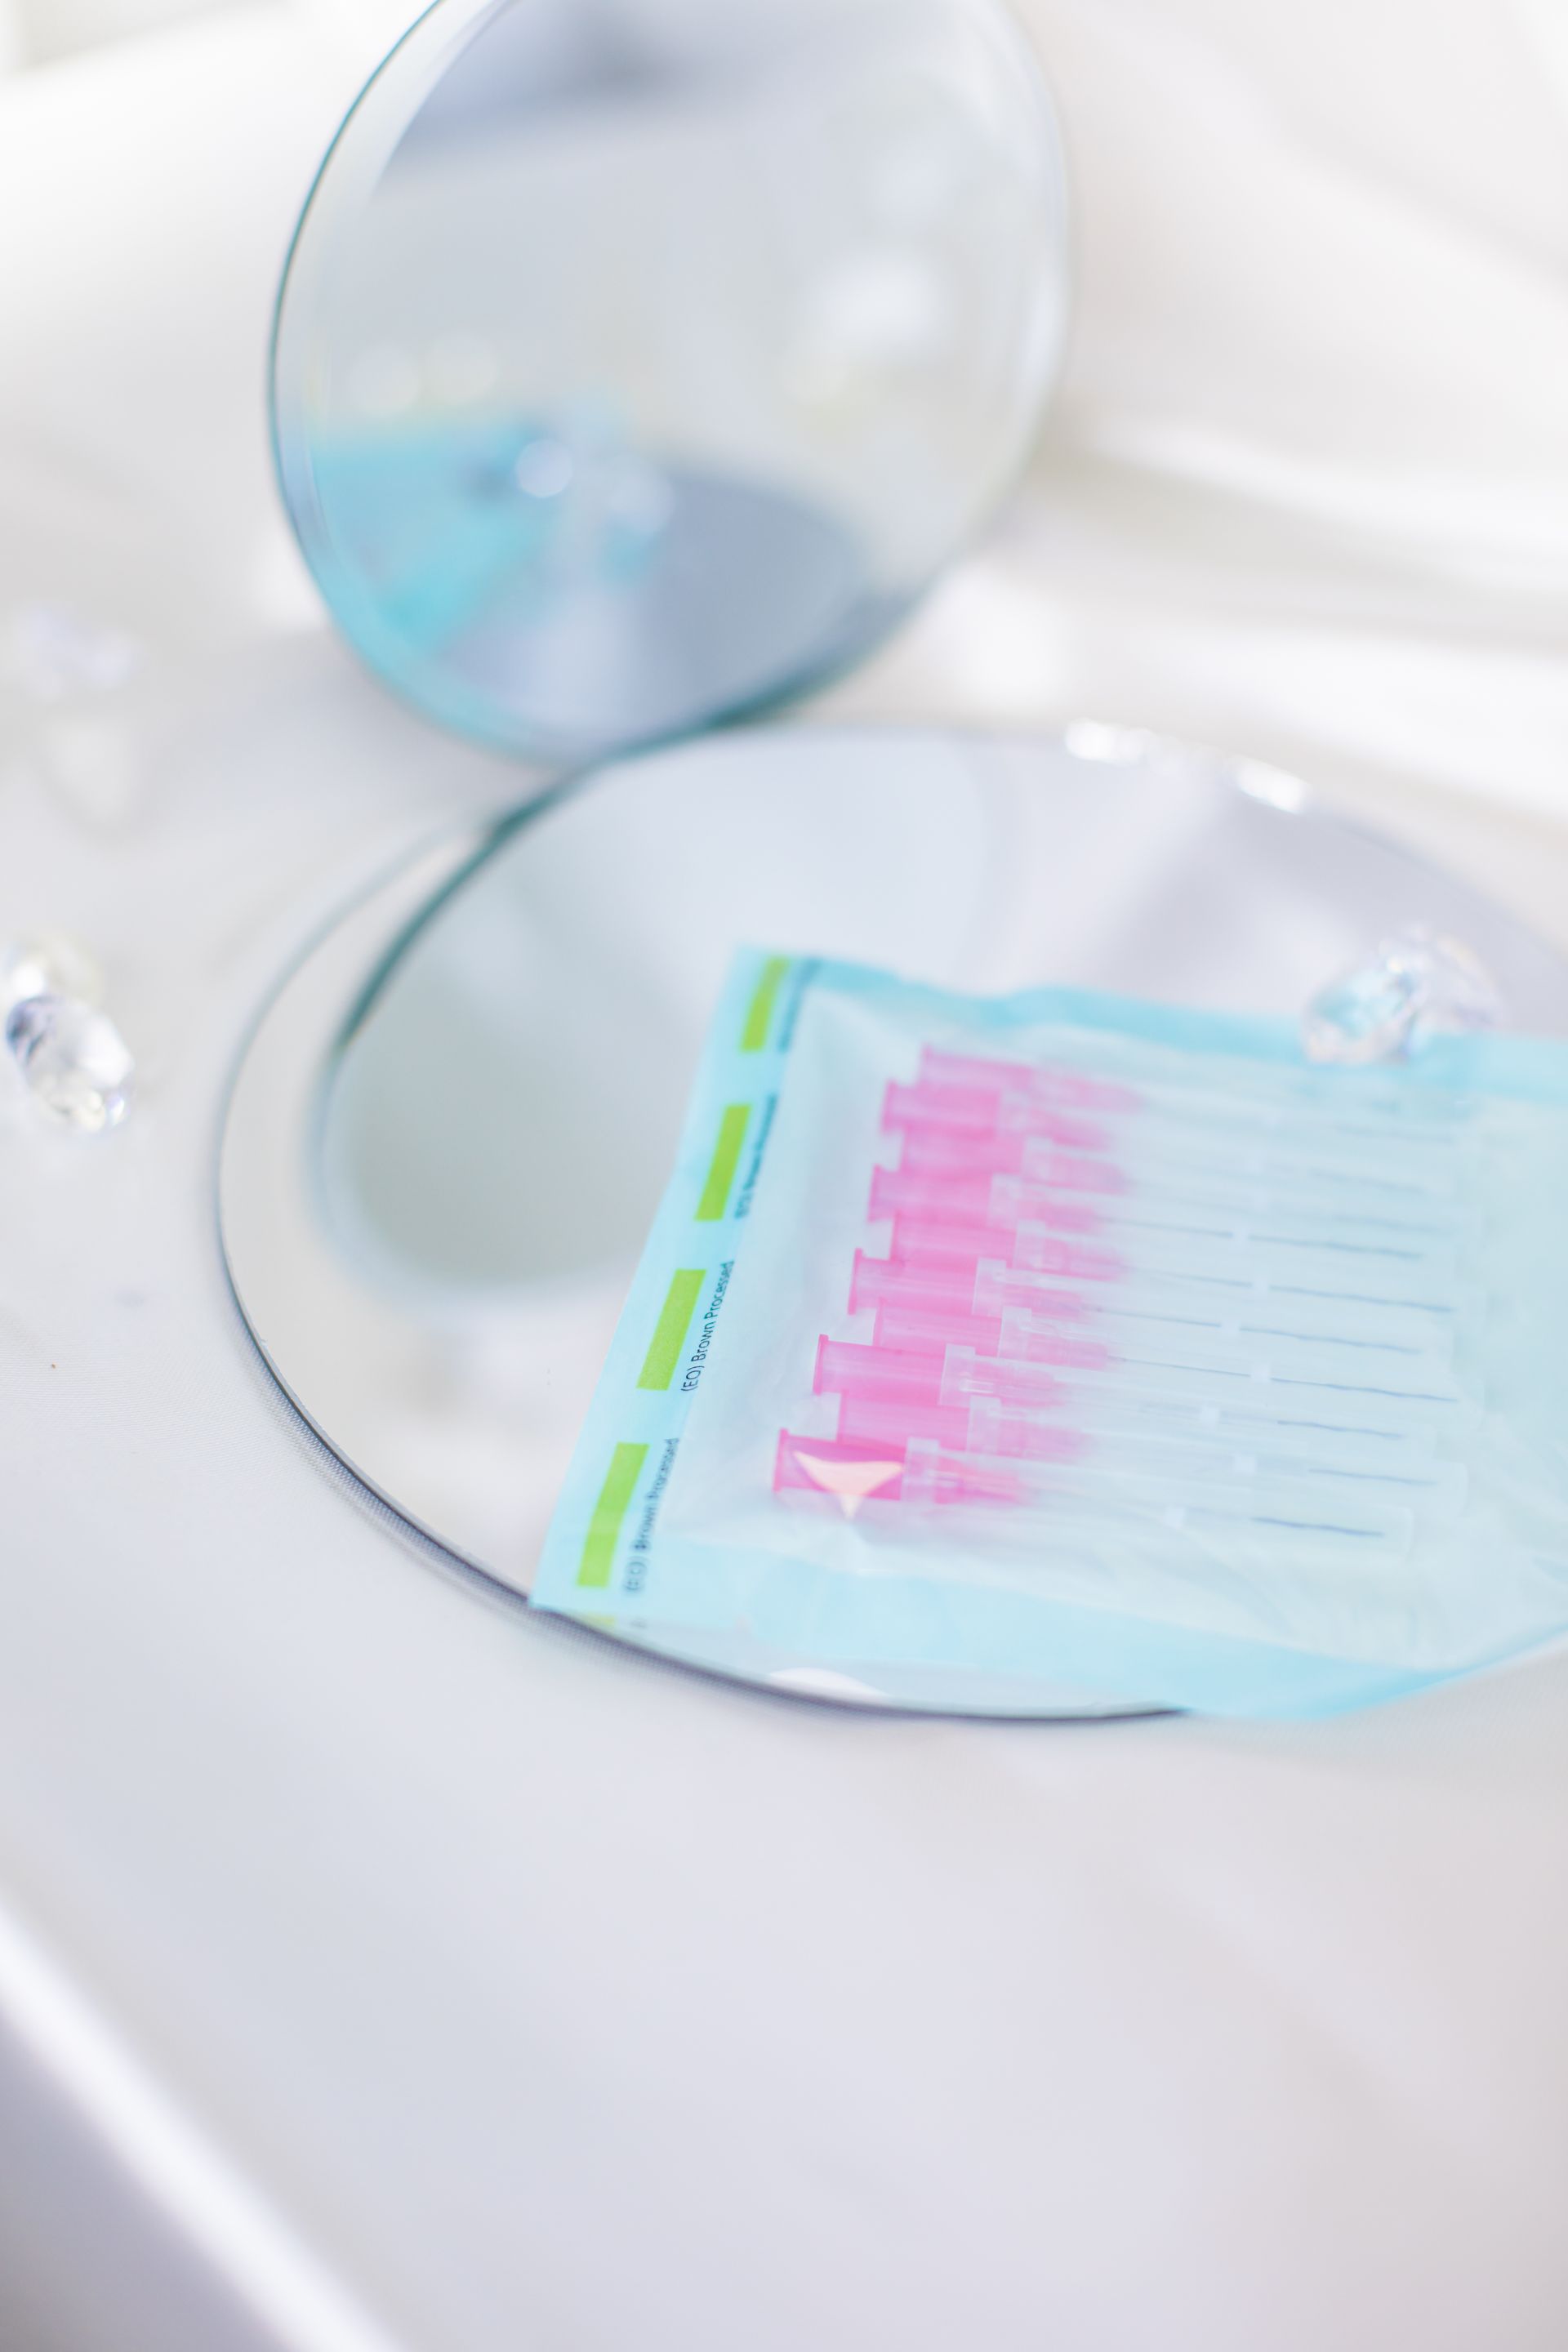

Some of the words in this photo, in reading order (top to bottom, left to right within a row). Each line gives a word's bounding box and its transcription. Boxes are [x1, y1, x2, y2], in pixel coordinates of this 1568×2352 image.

[704, 1260, 735, 1320] Processed
[691, 1321, 717, 1362] Brown
[680, 1365, 705, 1392] (EO)
[629, 1503, 657, 1551] Brown
